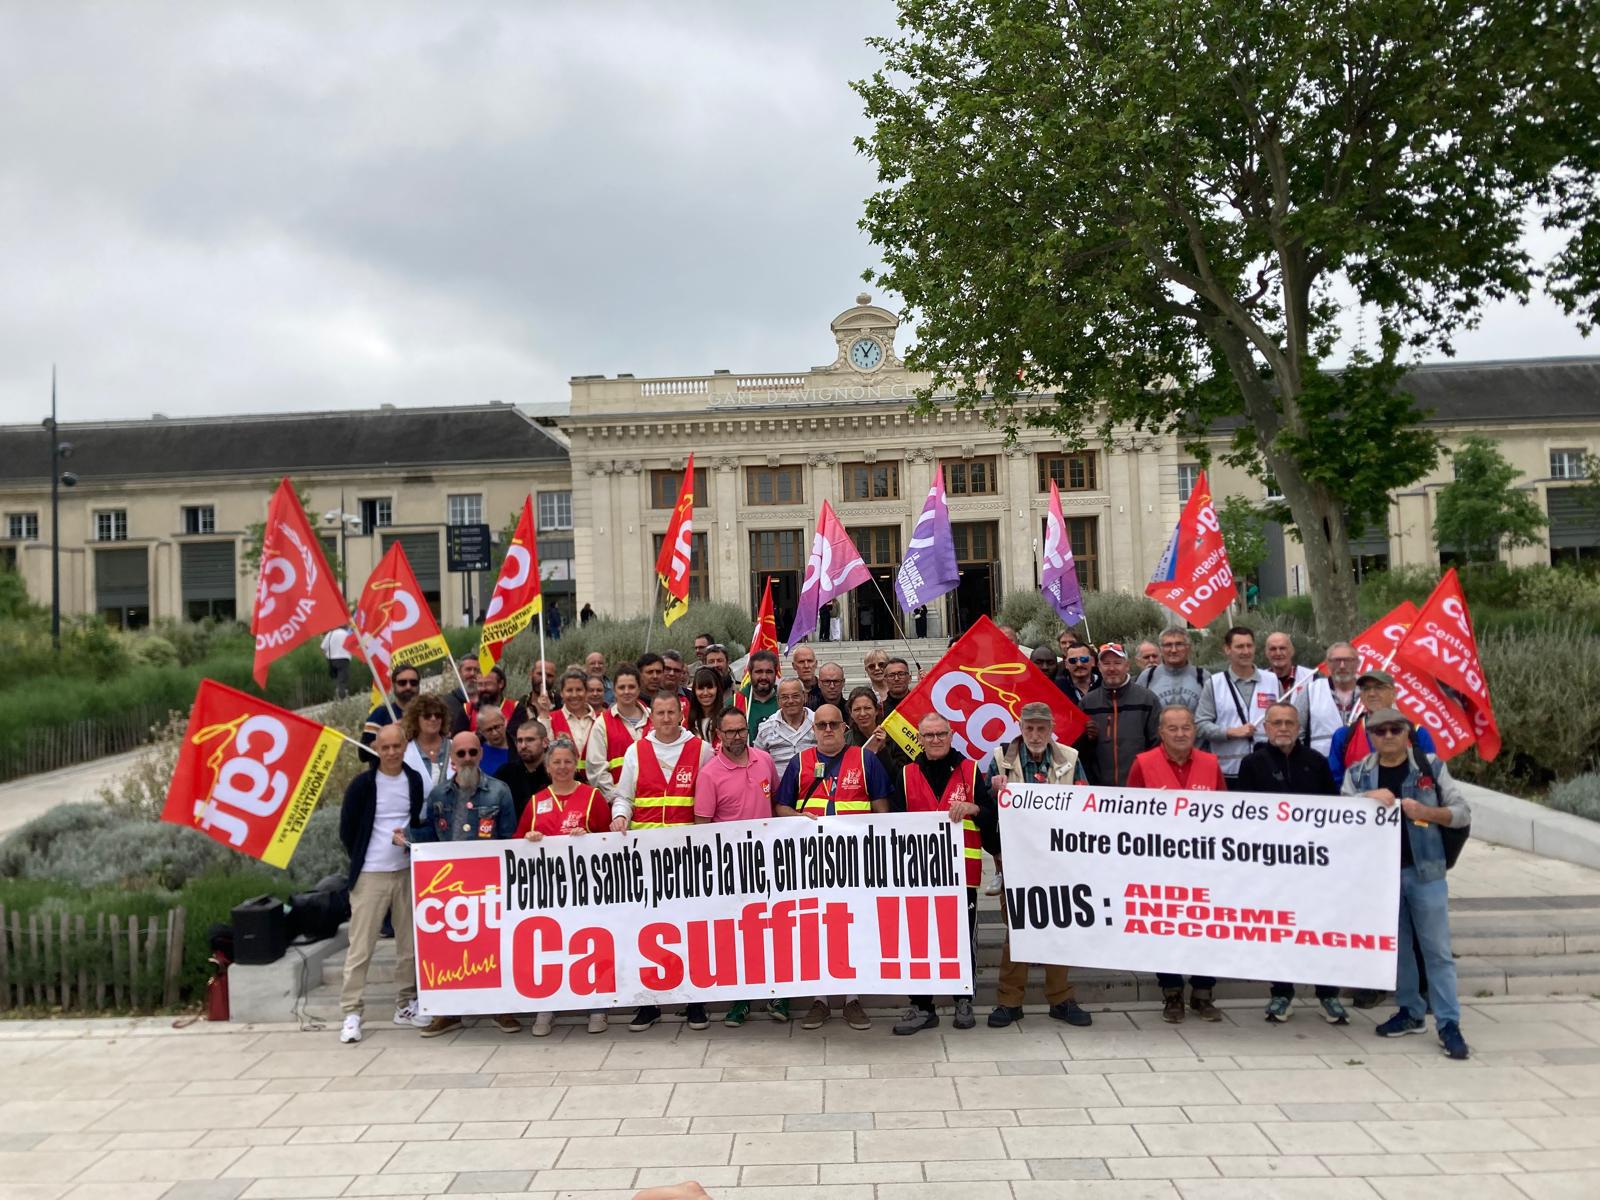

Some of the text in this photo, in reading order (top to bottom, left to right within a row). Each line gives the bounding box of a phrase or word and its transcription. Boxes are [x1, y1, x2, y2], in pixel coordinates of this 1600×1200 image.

[708, 391, 754, 405] GARE
[767, 385, 881, 403] D'AVIGNON
[902, 556, 925, 589] FRANCE
[912, 551, 921, 560] LA
[1425, 621, 1472, 658] Centre
[1402, 672, 1470, 740] Hospitalier
[998, 787, 1400, 828] Collectif Amiante Pays des Sorgues 84
[1050, 828, 1329, 867] Notre Collectif Sorguais
[418, 862, 501, 898] la
[505, 822, 960, 911] Perdre la santé, perdre la vie, en raison du travail:
[1005, 883, 1095, 930] VOUS
[1123, 882, 1211, 903] AIDE
[415, 884, 501, 942] cgt
[1124, 900, 1297, 926] INFORME
[512, 895, 961, 999] Ca suffit !!!
[1123, 917, 1397, 952] ACCOMPAGNE
